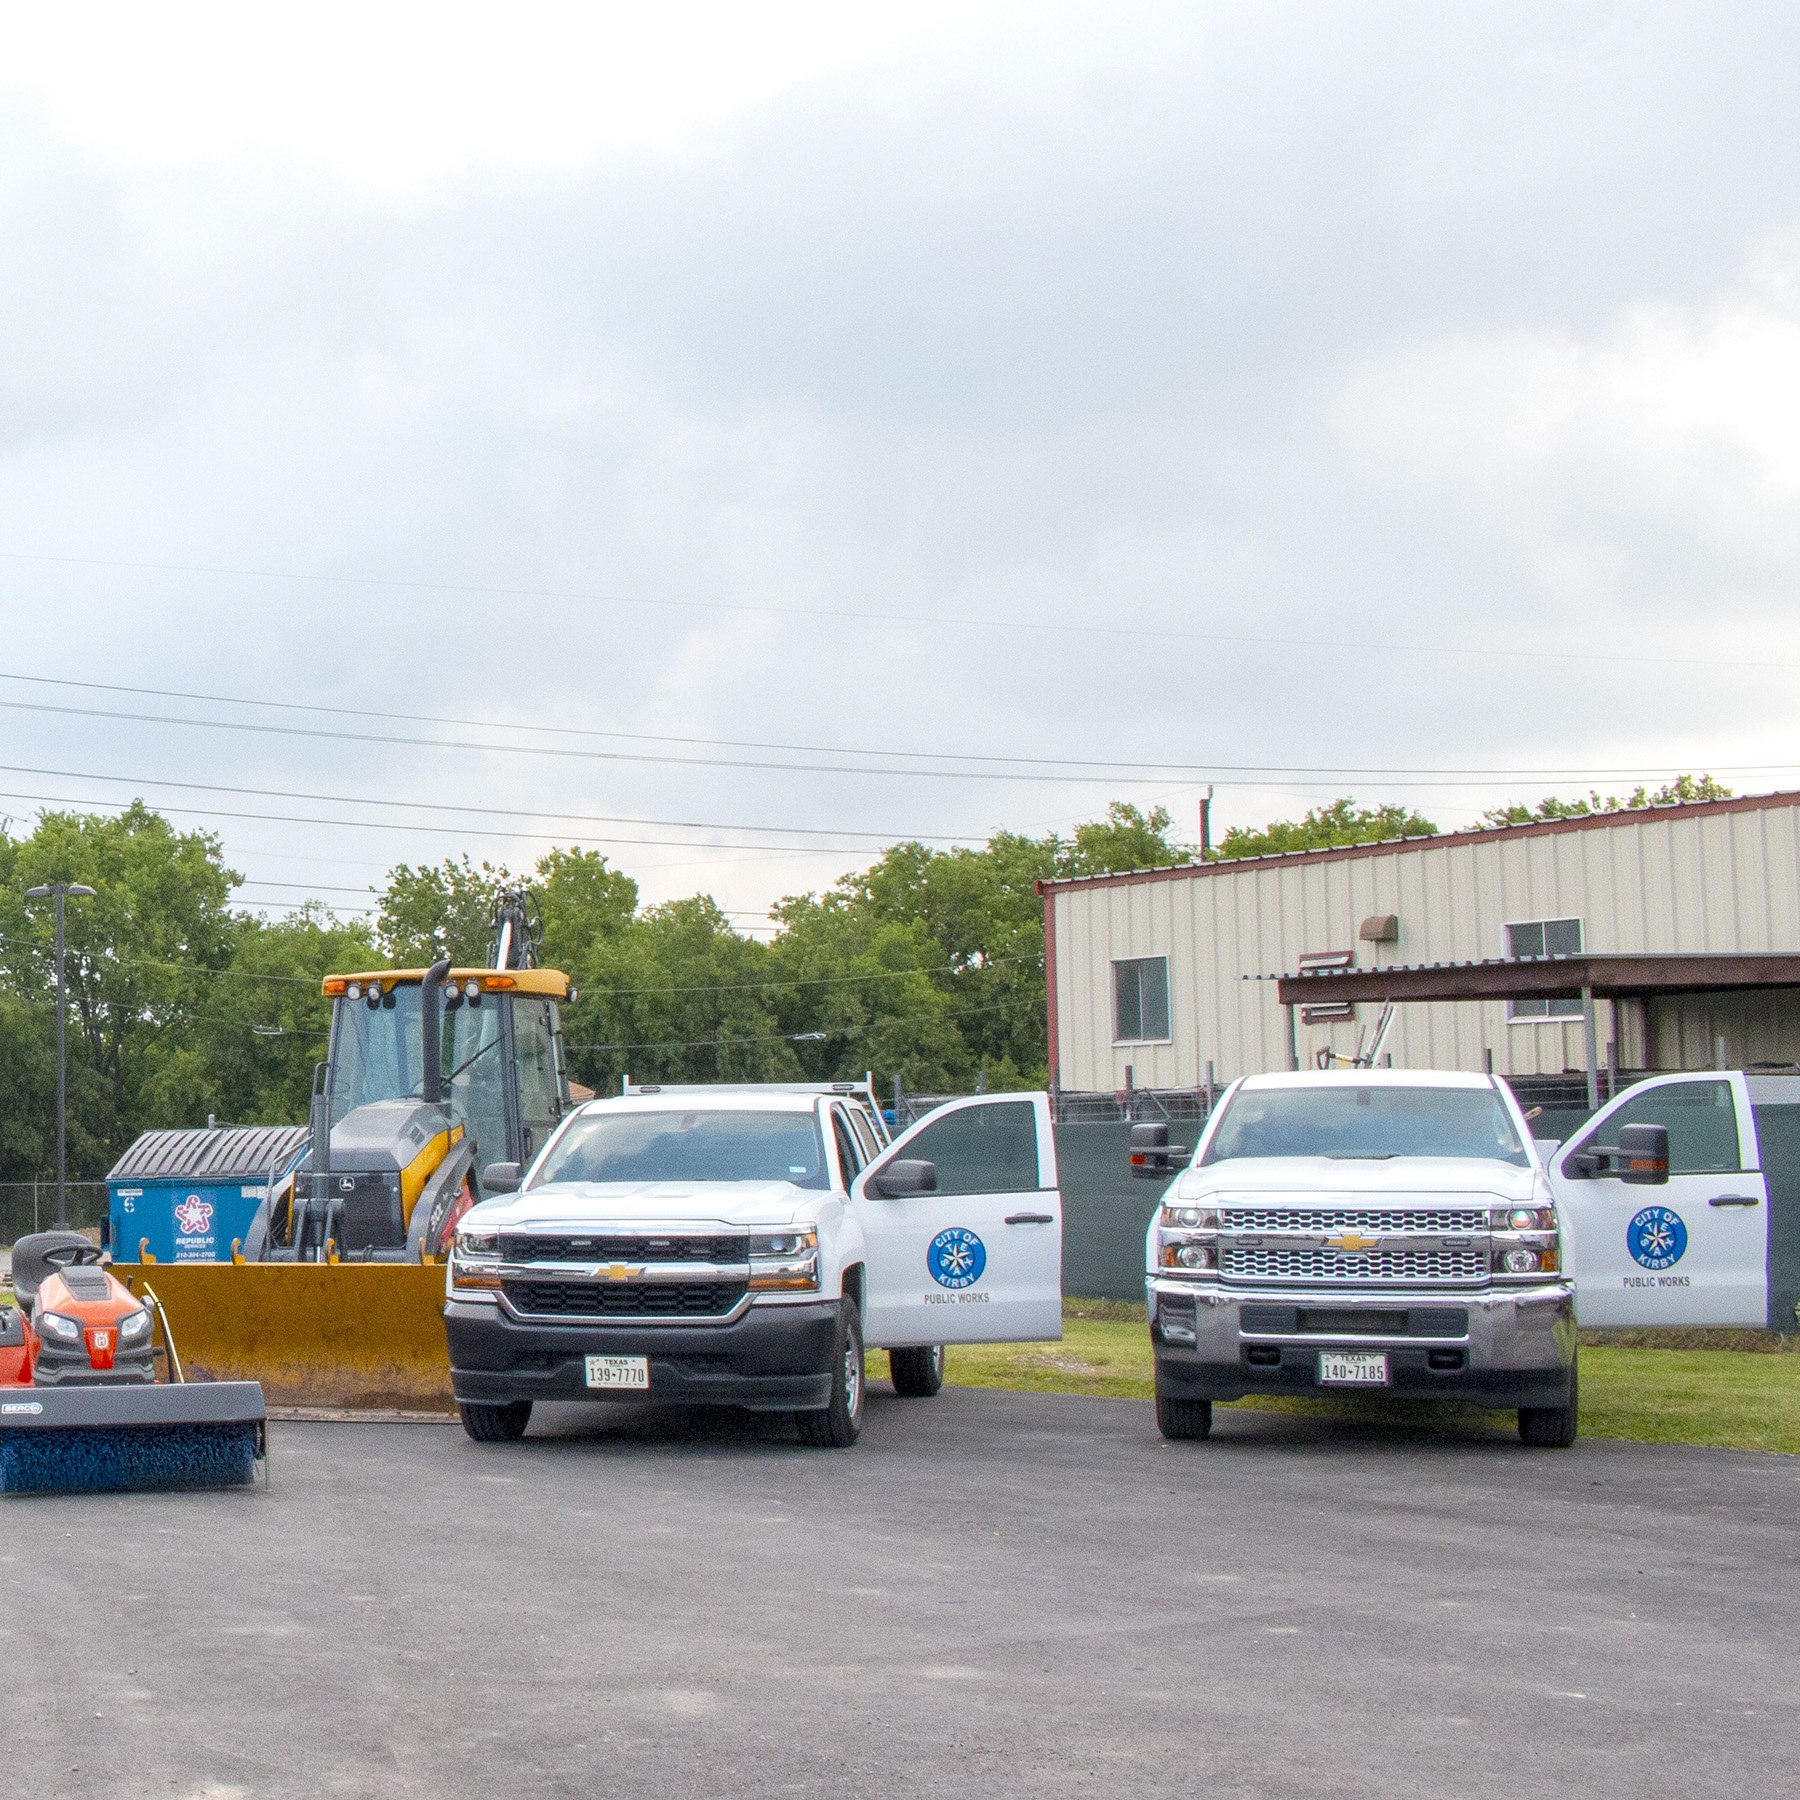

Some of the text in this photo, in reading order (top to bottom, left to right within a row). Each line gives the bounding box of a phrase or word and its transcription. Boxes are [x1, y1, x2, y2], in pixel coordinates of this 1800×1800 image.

[1634, 1209, 1680, 1226] CITY OF
[176, 1237, 215, 1245] REPUBLIC
[935, 1230, 980, 1248] CITY OF
[1640, 1222, 1675, 1256] TEXAS
[940, 1242, 974, 1276] TEXAS
[1638, 1253, 1676, 1269] KIRBY
[938, 1273, 975, 1288] KIRBY
[1623, 1276, 1690, 1288] PUBLIC WORKS
[924, 1293, 989, 1304] PUBLIC WORKS
